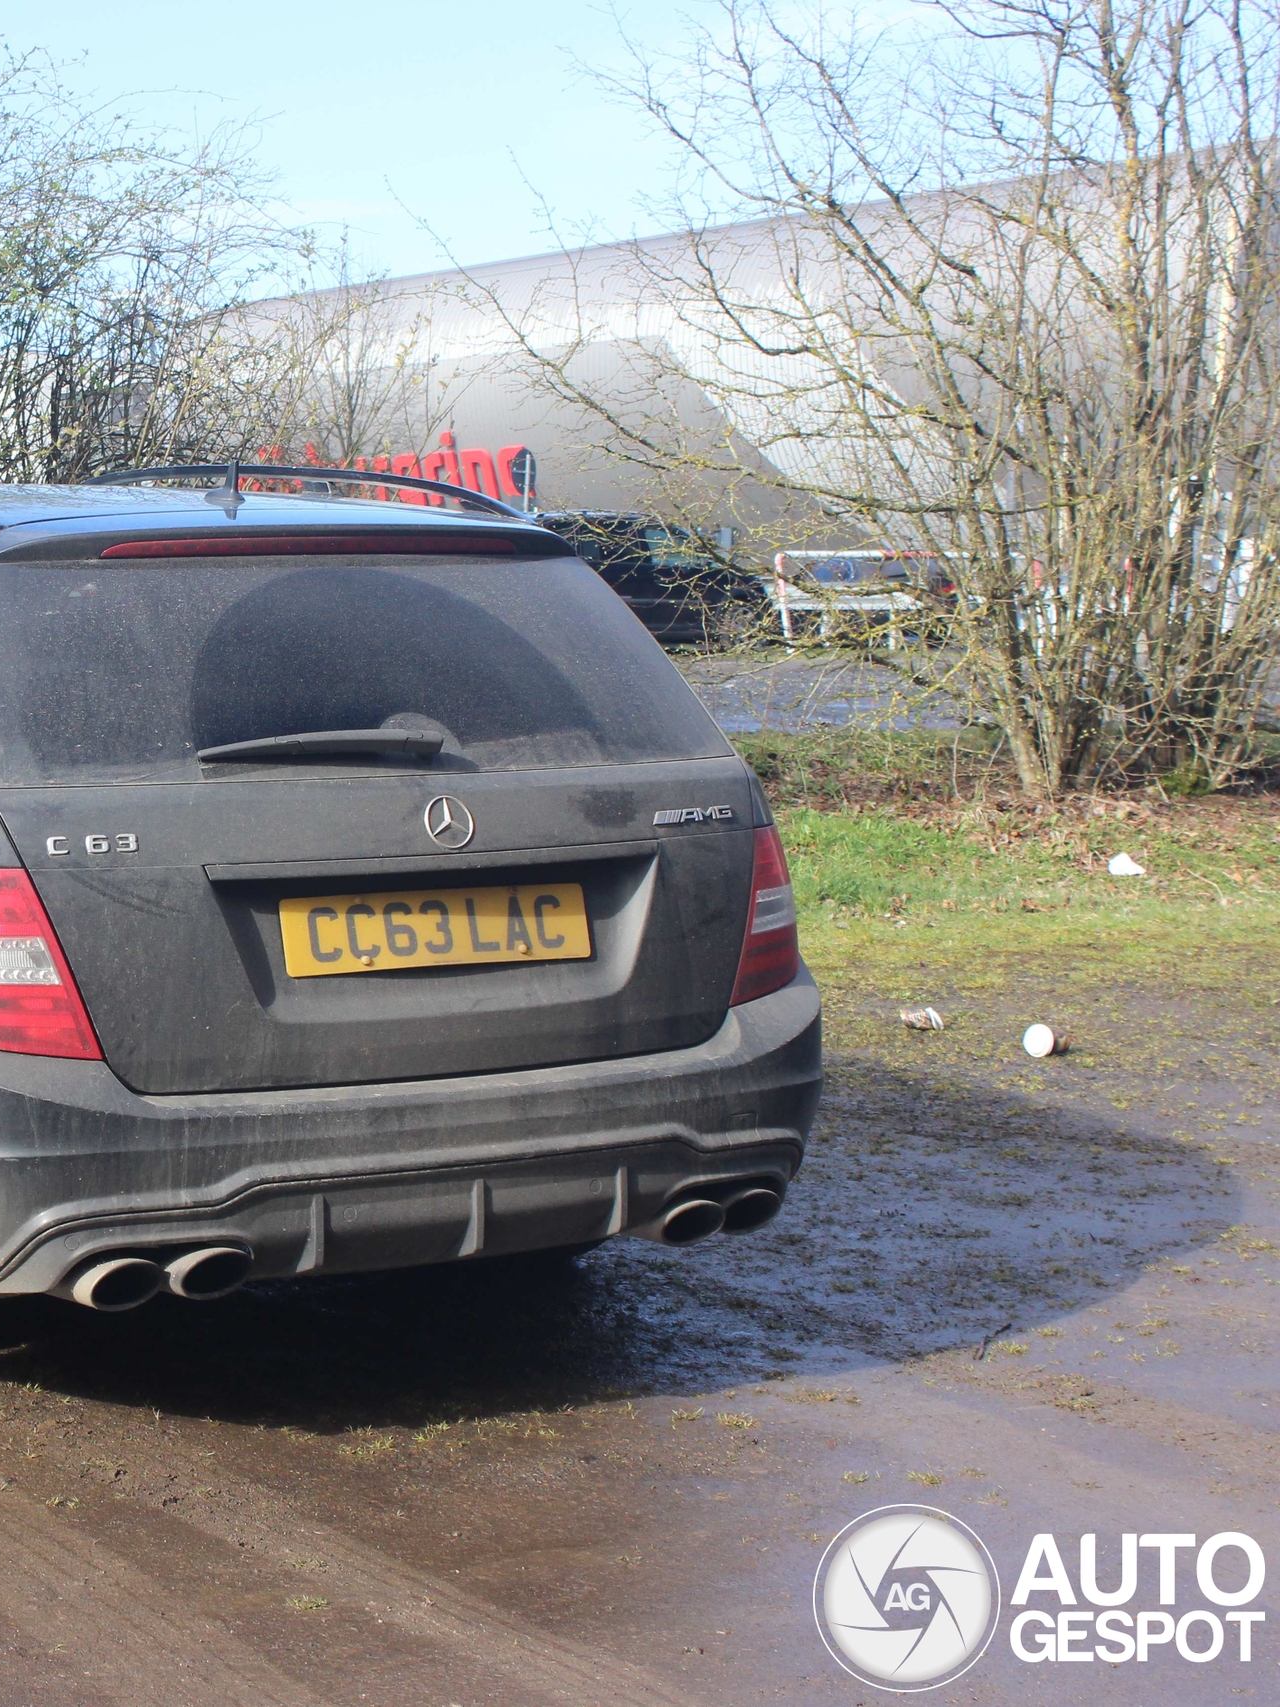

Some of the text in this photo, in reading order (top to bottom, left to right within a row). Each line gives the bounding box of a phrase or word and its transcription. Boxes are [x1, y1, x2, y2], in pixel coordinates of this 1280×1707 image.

[680, 805, 733, 823] AMG
[46, 833, 139, 855] C 63
[307, 894, 566, 962] CC63 LAC
